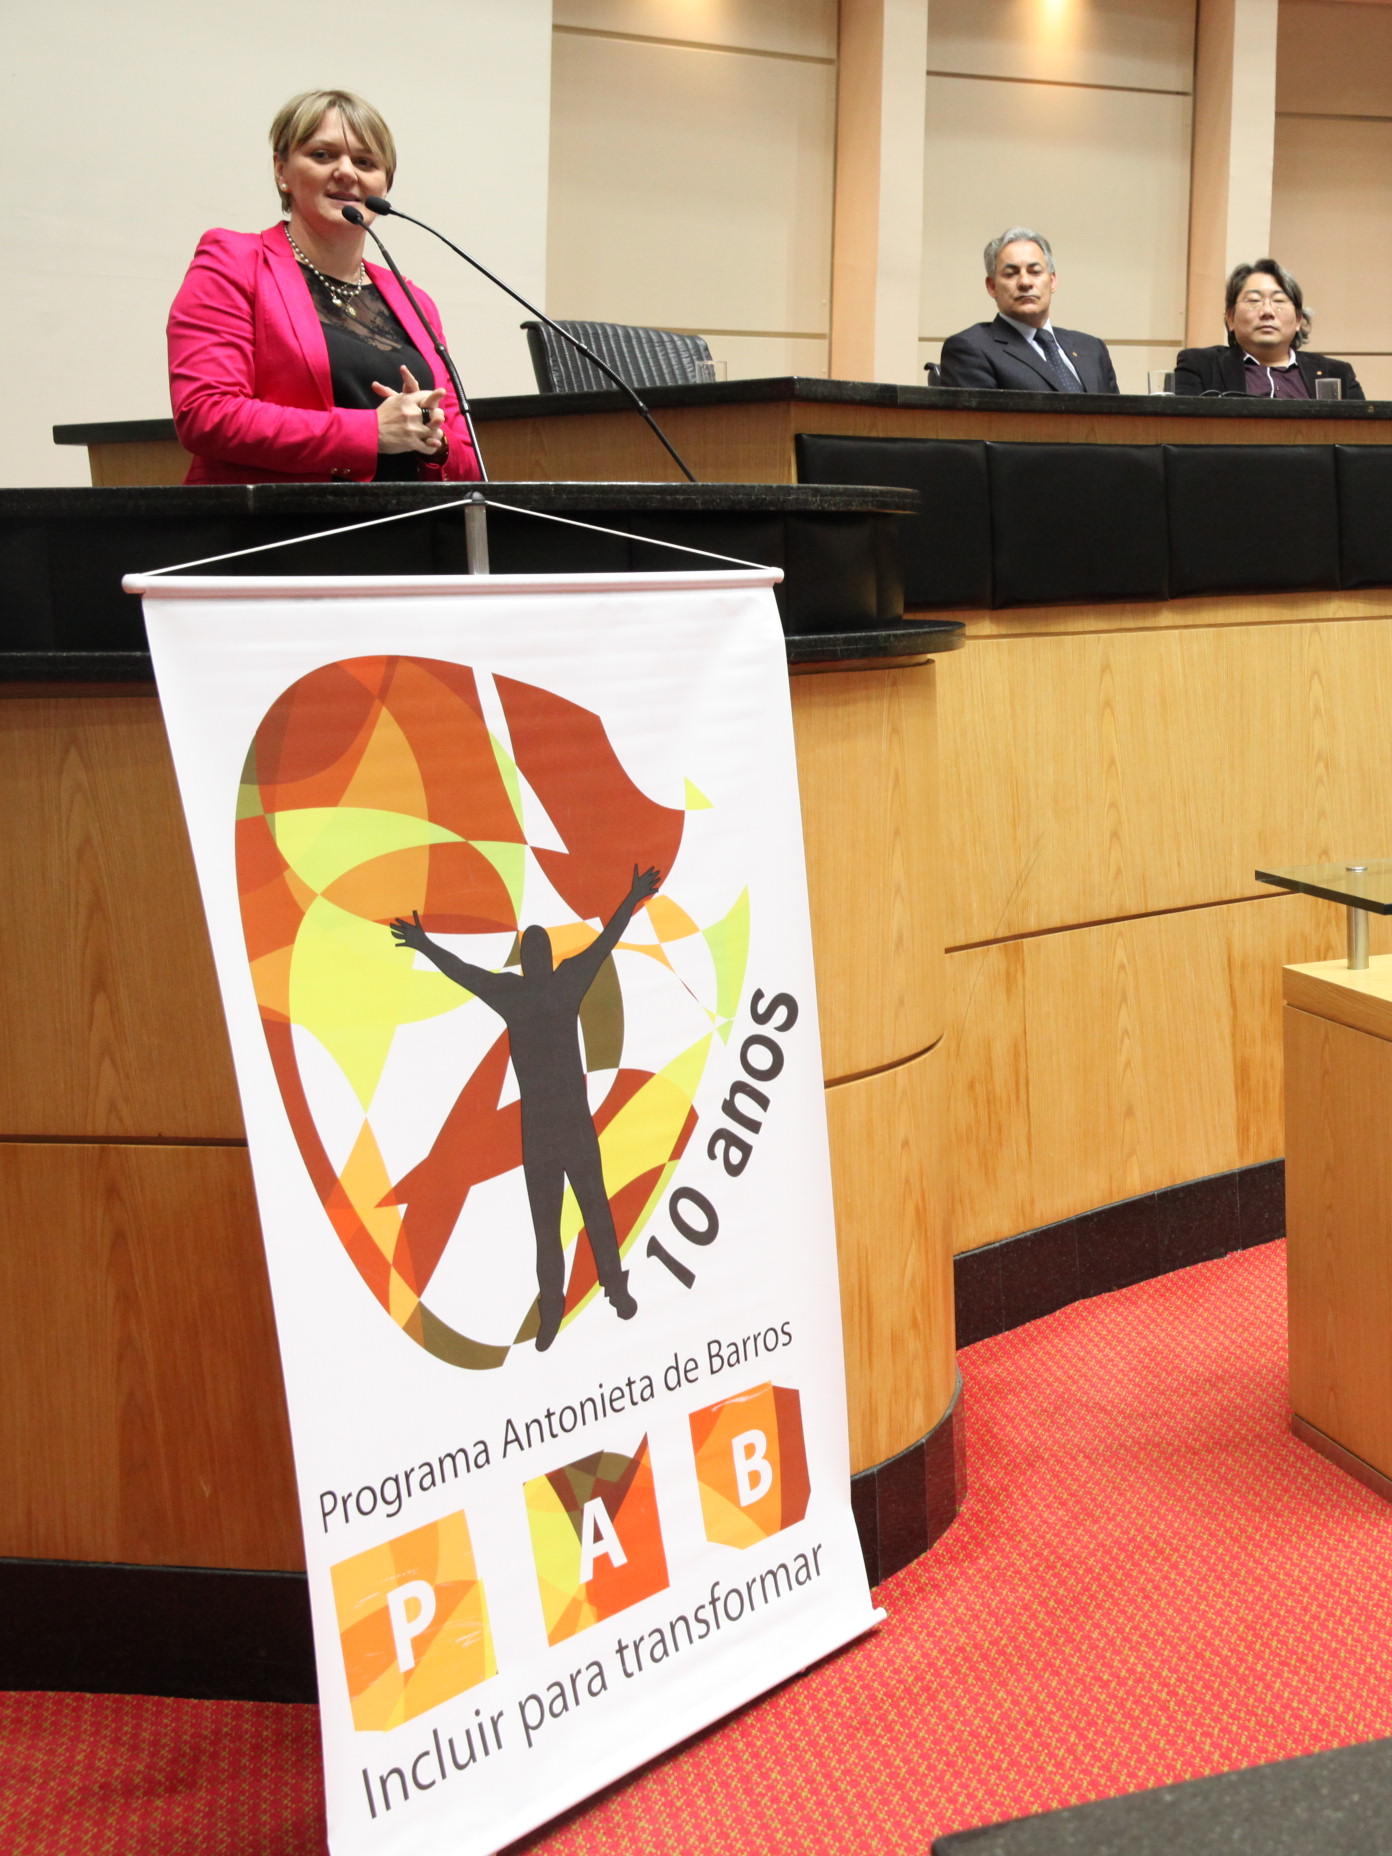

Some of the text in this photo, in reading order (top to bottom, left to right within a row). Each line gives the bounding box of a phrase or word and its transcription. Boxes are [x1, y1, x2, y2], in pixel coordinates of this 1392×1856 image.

[646, 987, 799, 1290] 10 anos
[319, 1321, 793, 1533] Programa Antonieta de Barros
[386, 1429, 773, 1673] P A B
[361, 1543, 822, 1819] Incluir para transformar
